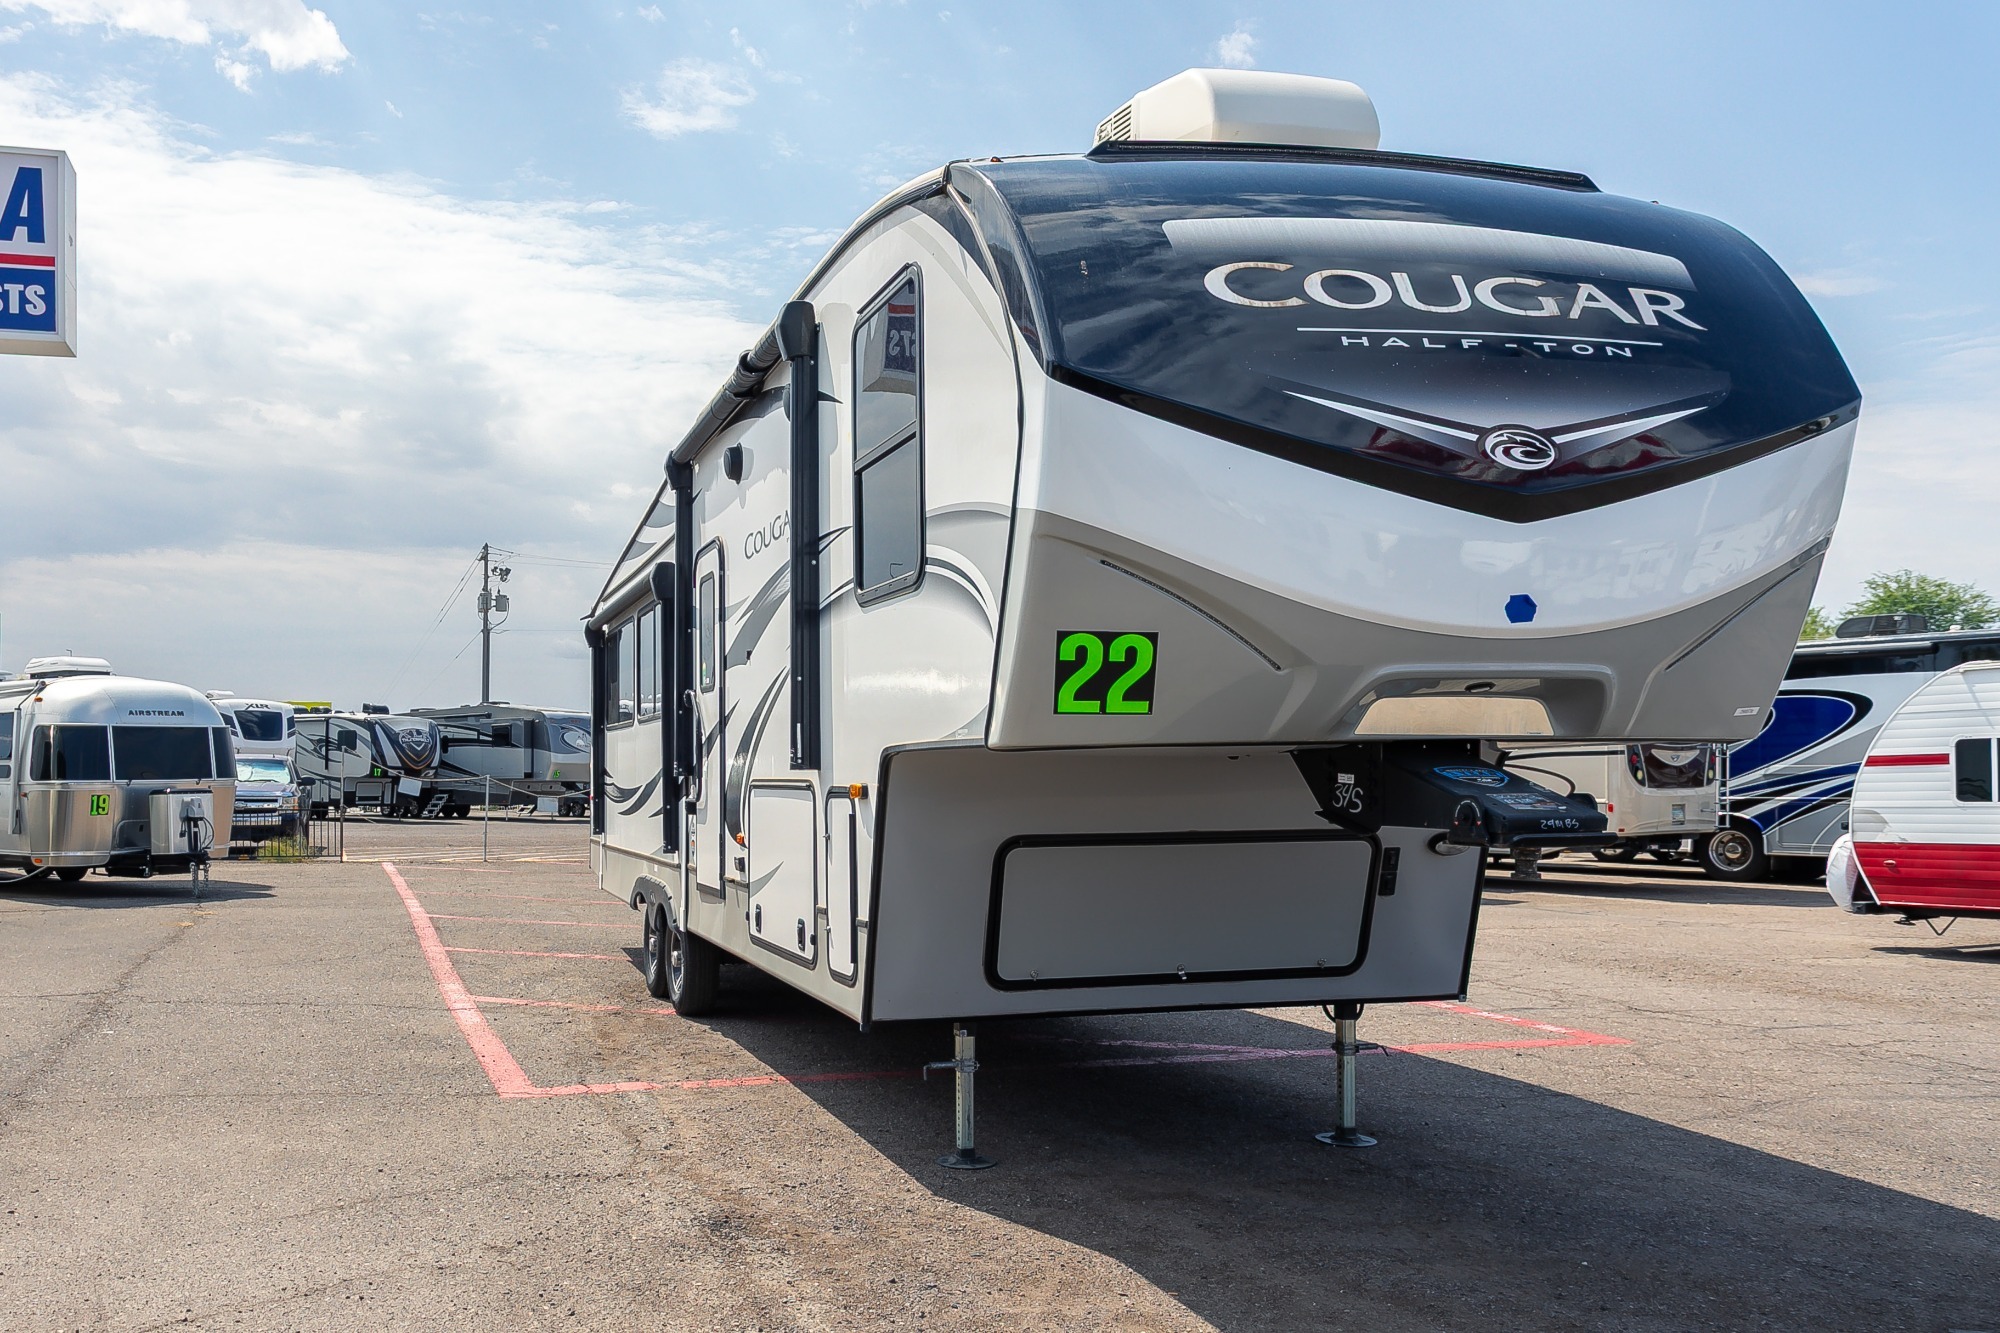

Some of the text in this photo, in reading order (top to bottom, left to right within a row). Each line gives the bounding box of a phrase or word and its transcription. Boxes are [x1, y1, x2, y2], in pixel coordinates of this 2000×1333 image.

[0, 166, 45, 244] A
[0, 283, 47, 316] TS
[1203, 261, 1708, 331] COUGAR
[1057, 632, 1154, 714] 22
[128, 709, 185, 717] AIRSTREAM
[245, 702, 271, 711] XLR
[91, 794, 110, 815] 19
